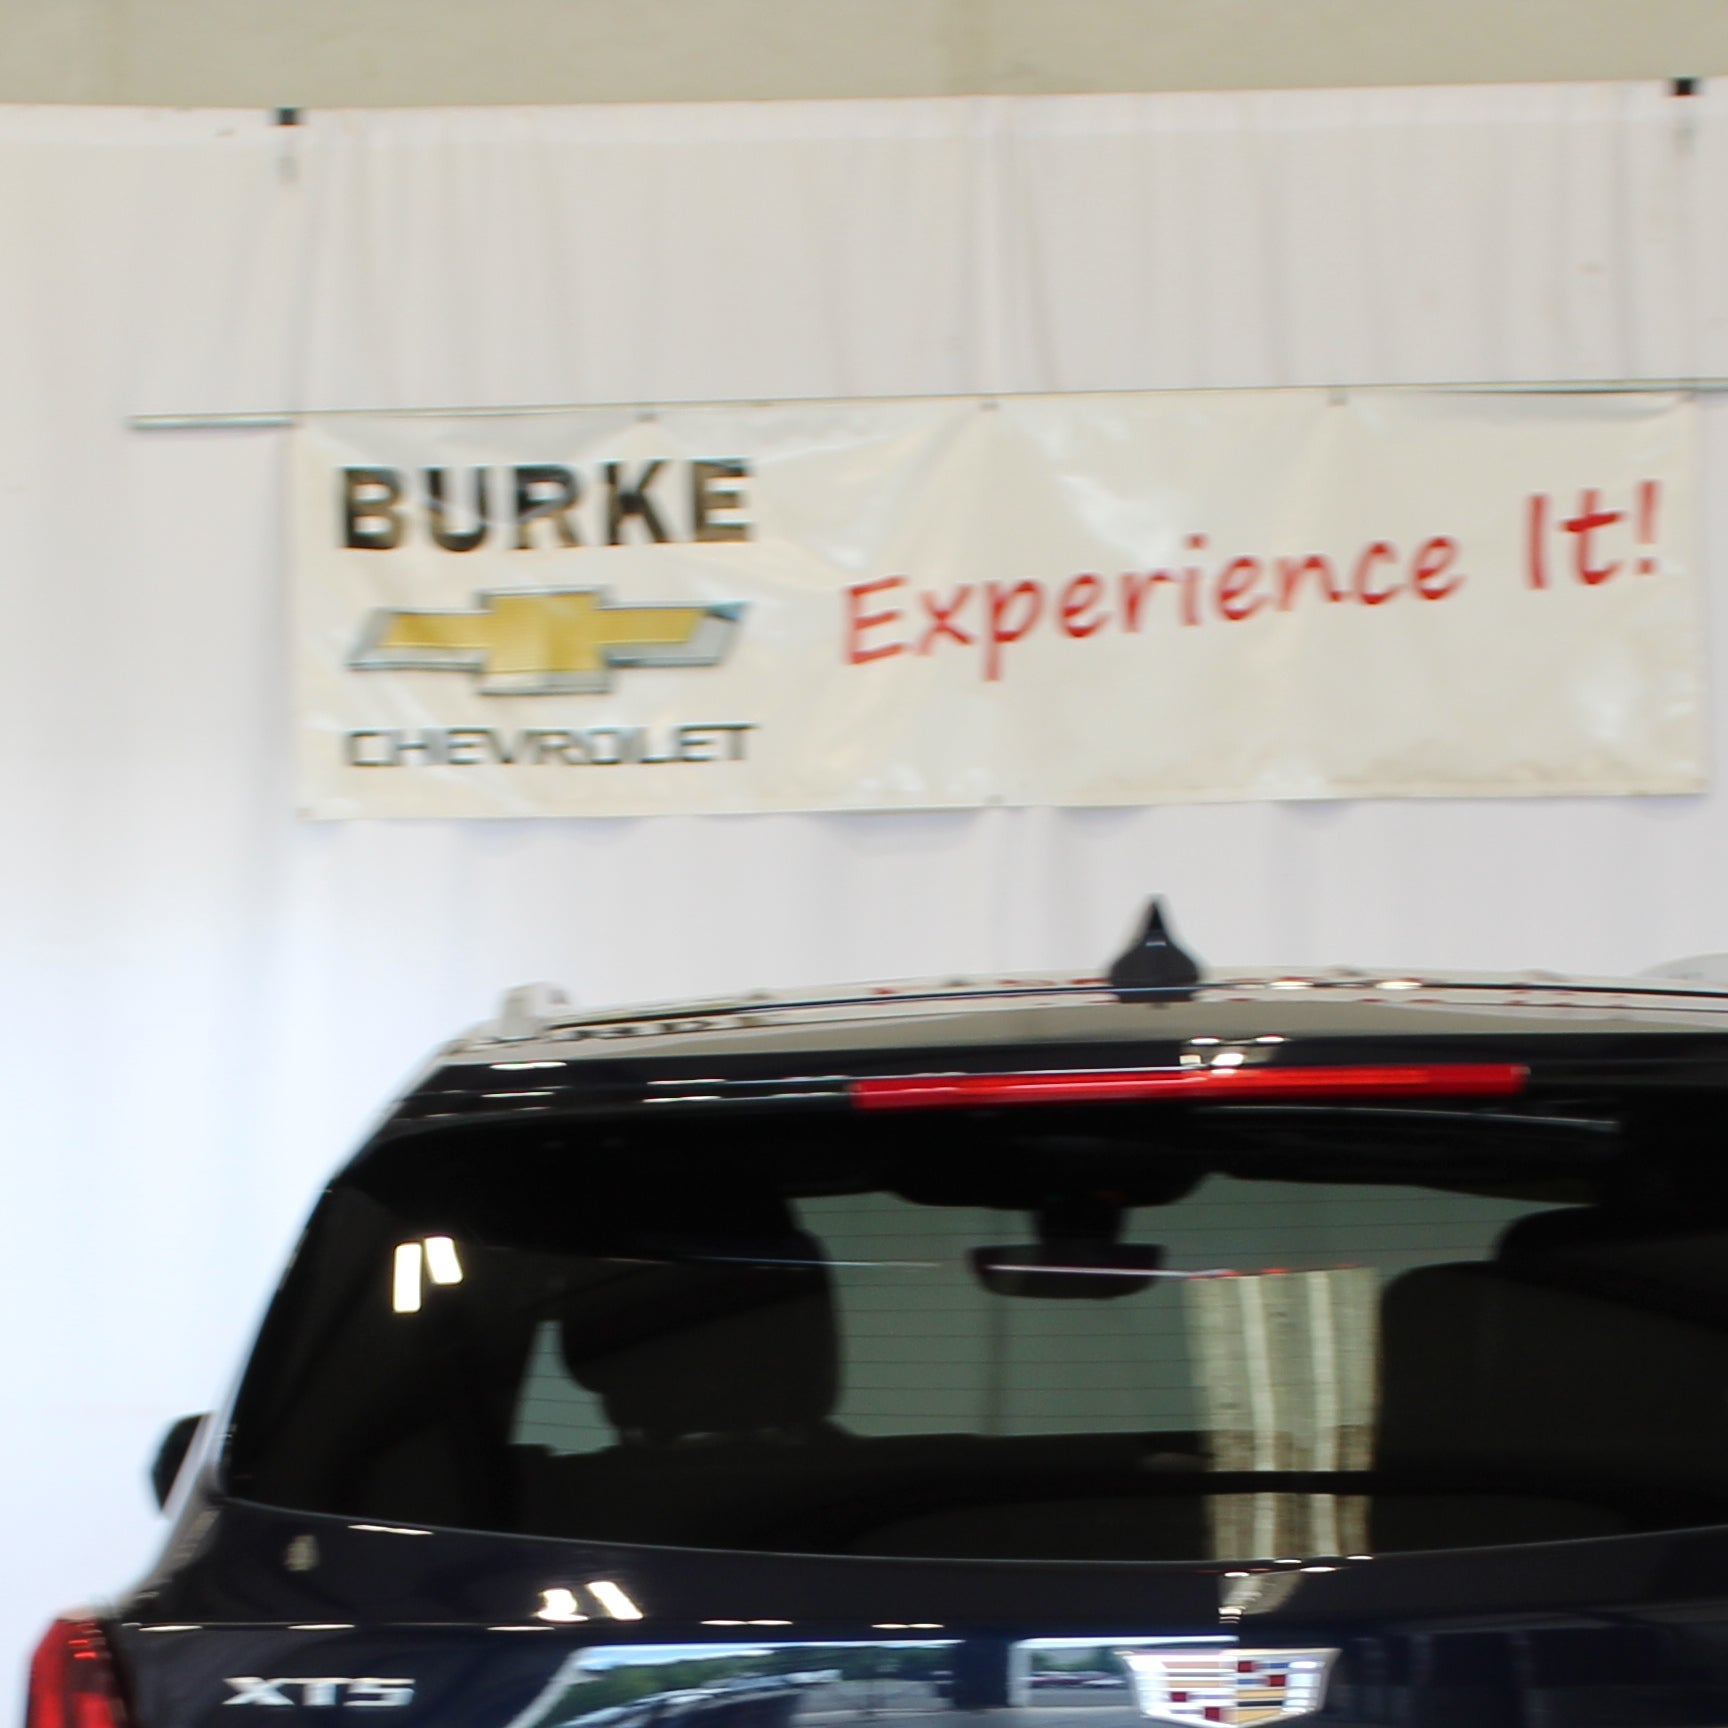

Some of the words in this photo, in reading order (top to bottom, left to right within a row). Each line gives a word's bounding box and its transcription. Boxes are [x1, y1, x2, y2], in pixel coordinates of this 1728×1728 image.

[338, 458, 754, 552] BURKE
[841, 532, 1468, 682] Experience
[1520, 479, 1664, 592] It!
[344, 722, 760, 766] CHEVROLET
[222, 1676, 416, 1706] XT5
